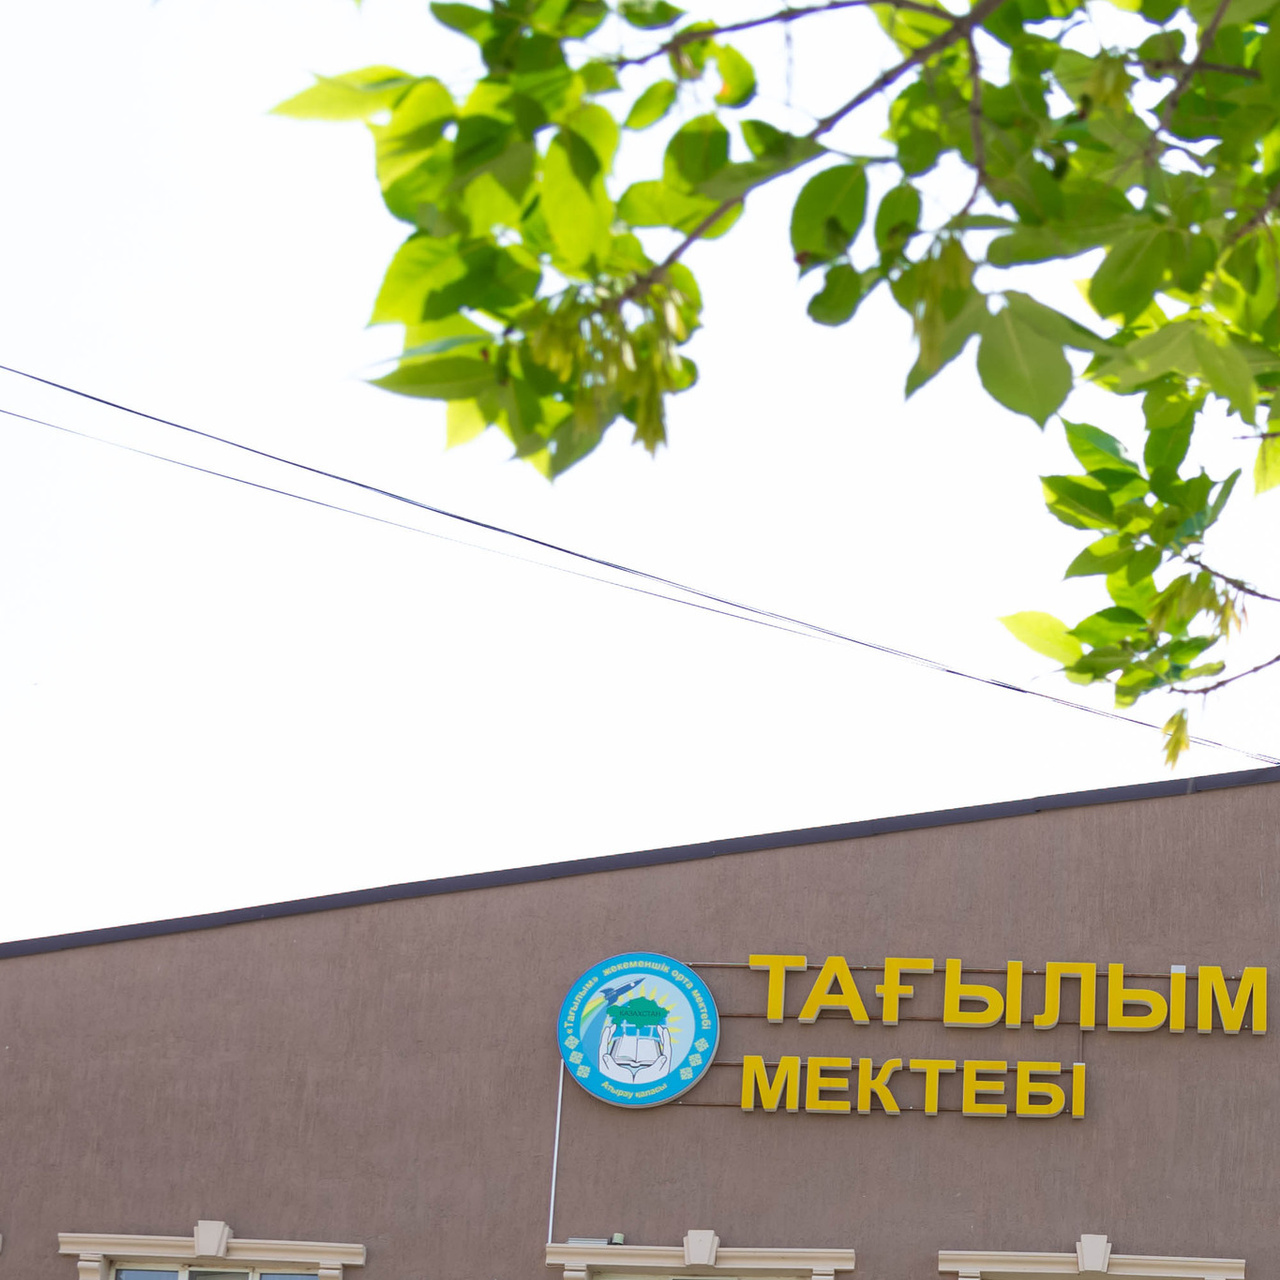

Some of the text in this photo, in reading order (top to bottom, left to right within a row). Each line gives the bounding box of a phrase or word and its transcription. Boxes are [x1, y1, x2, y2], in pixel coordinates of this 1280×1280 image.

[671, 970, 694, 989] орта
[692, 989, 711, 1030] мектебі
[749, 954, 1268, 1036] ТАҒЫЛЫМ
[741, 1055, 1086, 1119] МЕКТЕБІ
